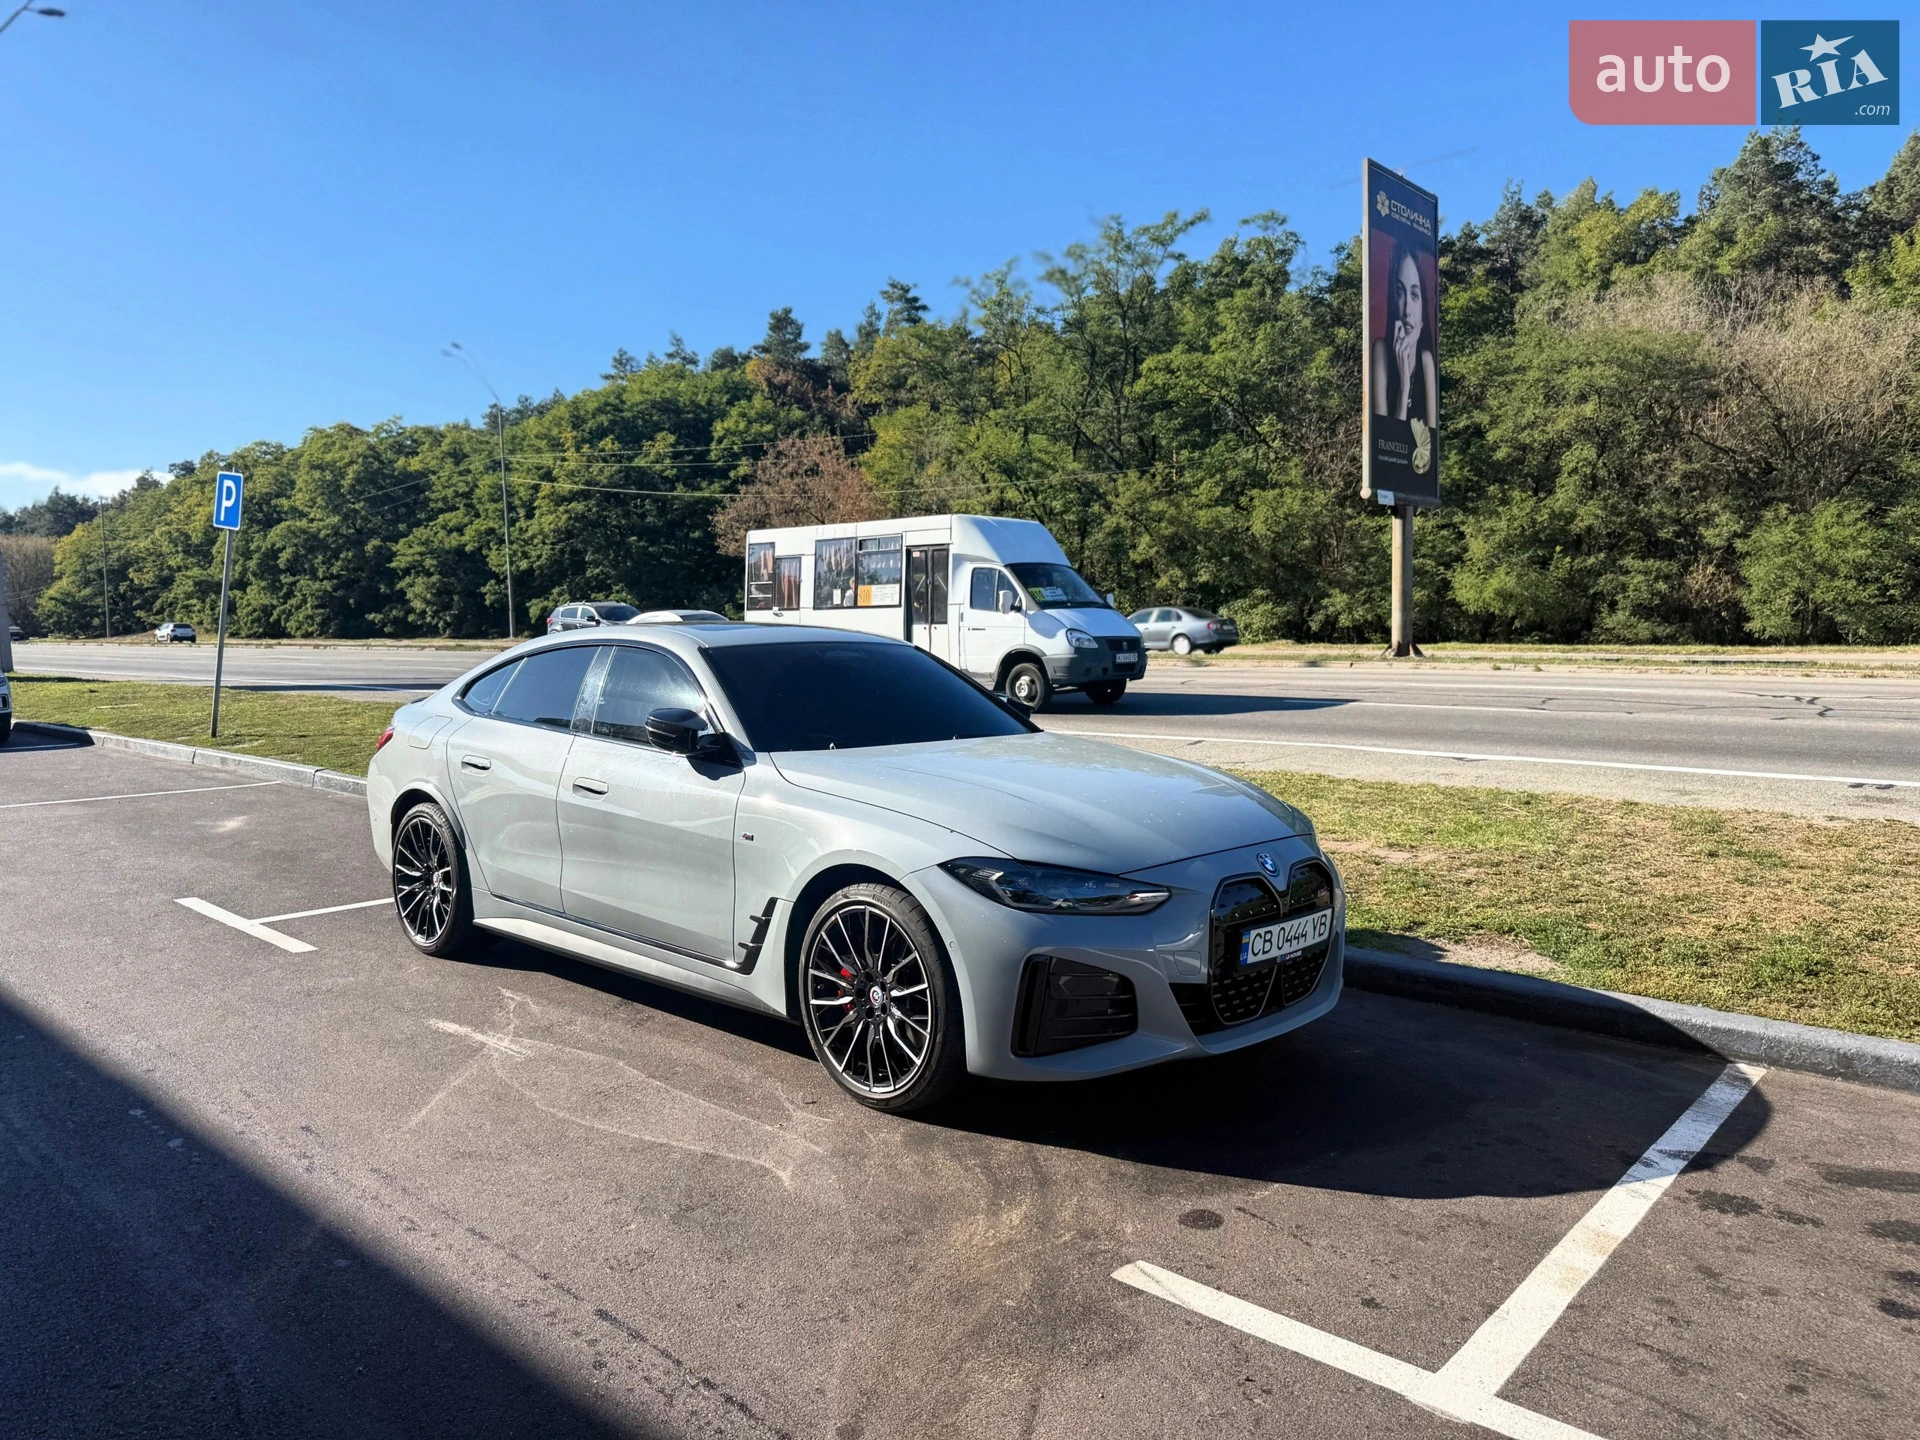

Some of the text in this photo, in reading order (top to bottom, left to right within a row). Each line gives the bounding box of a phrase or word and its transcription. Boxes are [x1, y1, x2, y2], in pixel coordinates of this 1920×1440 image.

[1390, 199, 1432, 231] СТОЛИЧНА
[1378, 439, 1409, 454] FRANCELLI
[220, 479, 236, 522] P
[1251, 913, 1328, 957] CB 0444 YB
